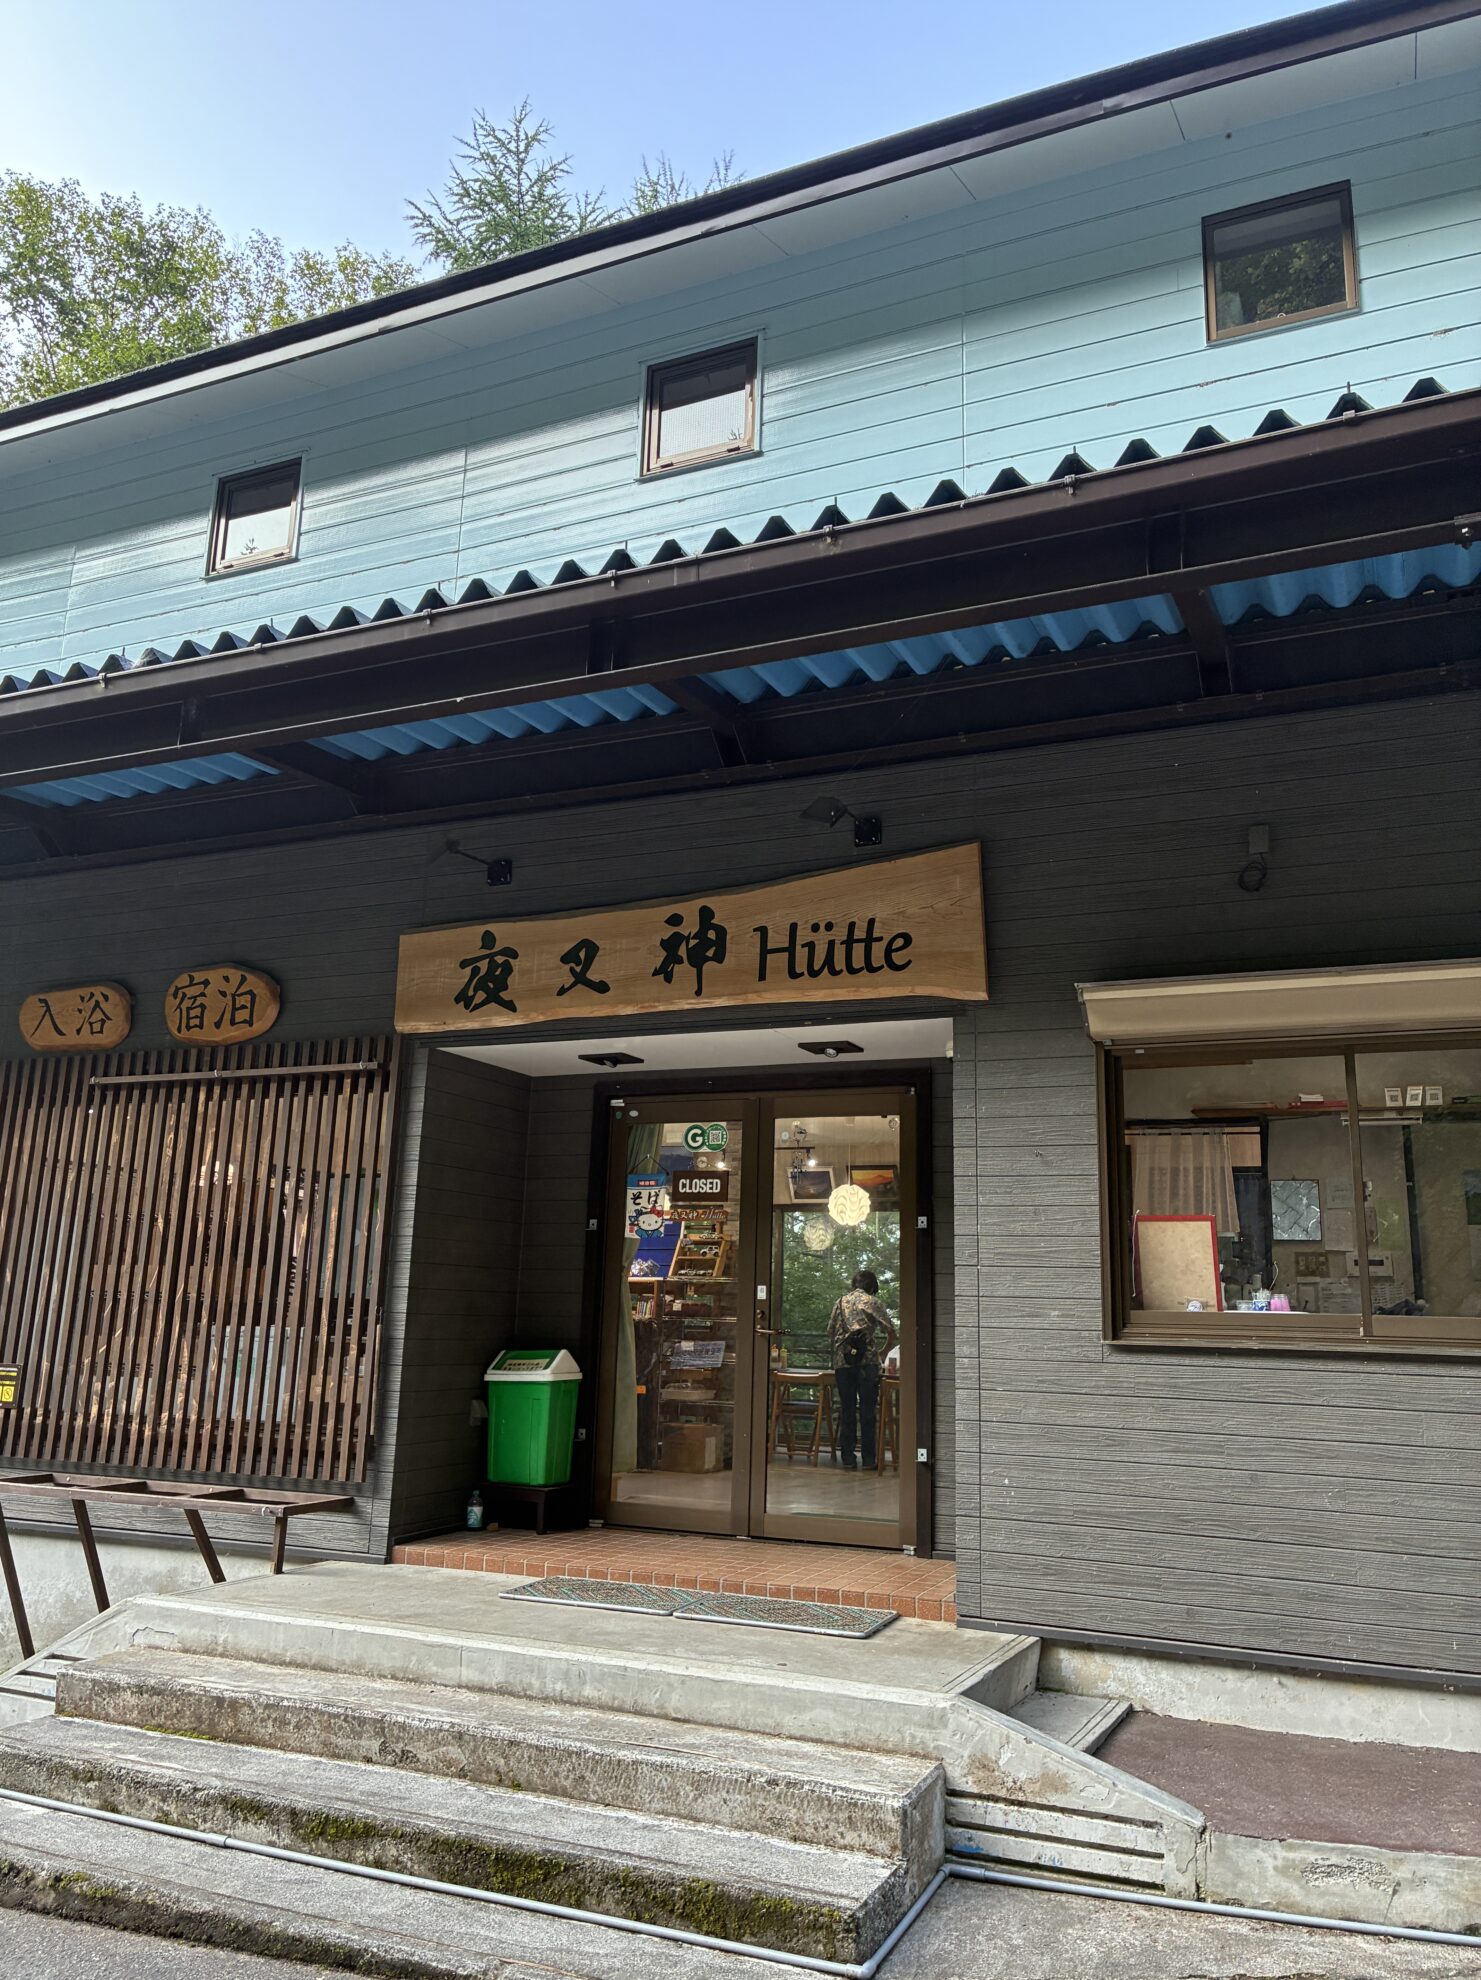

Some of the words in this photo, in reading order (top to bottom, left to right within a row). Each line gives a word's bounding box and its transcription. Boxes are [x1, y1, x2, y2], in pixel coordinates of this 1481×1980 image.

[454, 905, 728, 1012] 夜叉神
[752, 917, 913, 983] Hütte
[30, 991, 113, 1038] 入浴
[172, 973, 257, 1034] 宿泊
[630, 1189, 661, 1206] そば
[678, 1178, 721, 1193] CLOSED
